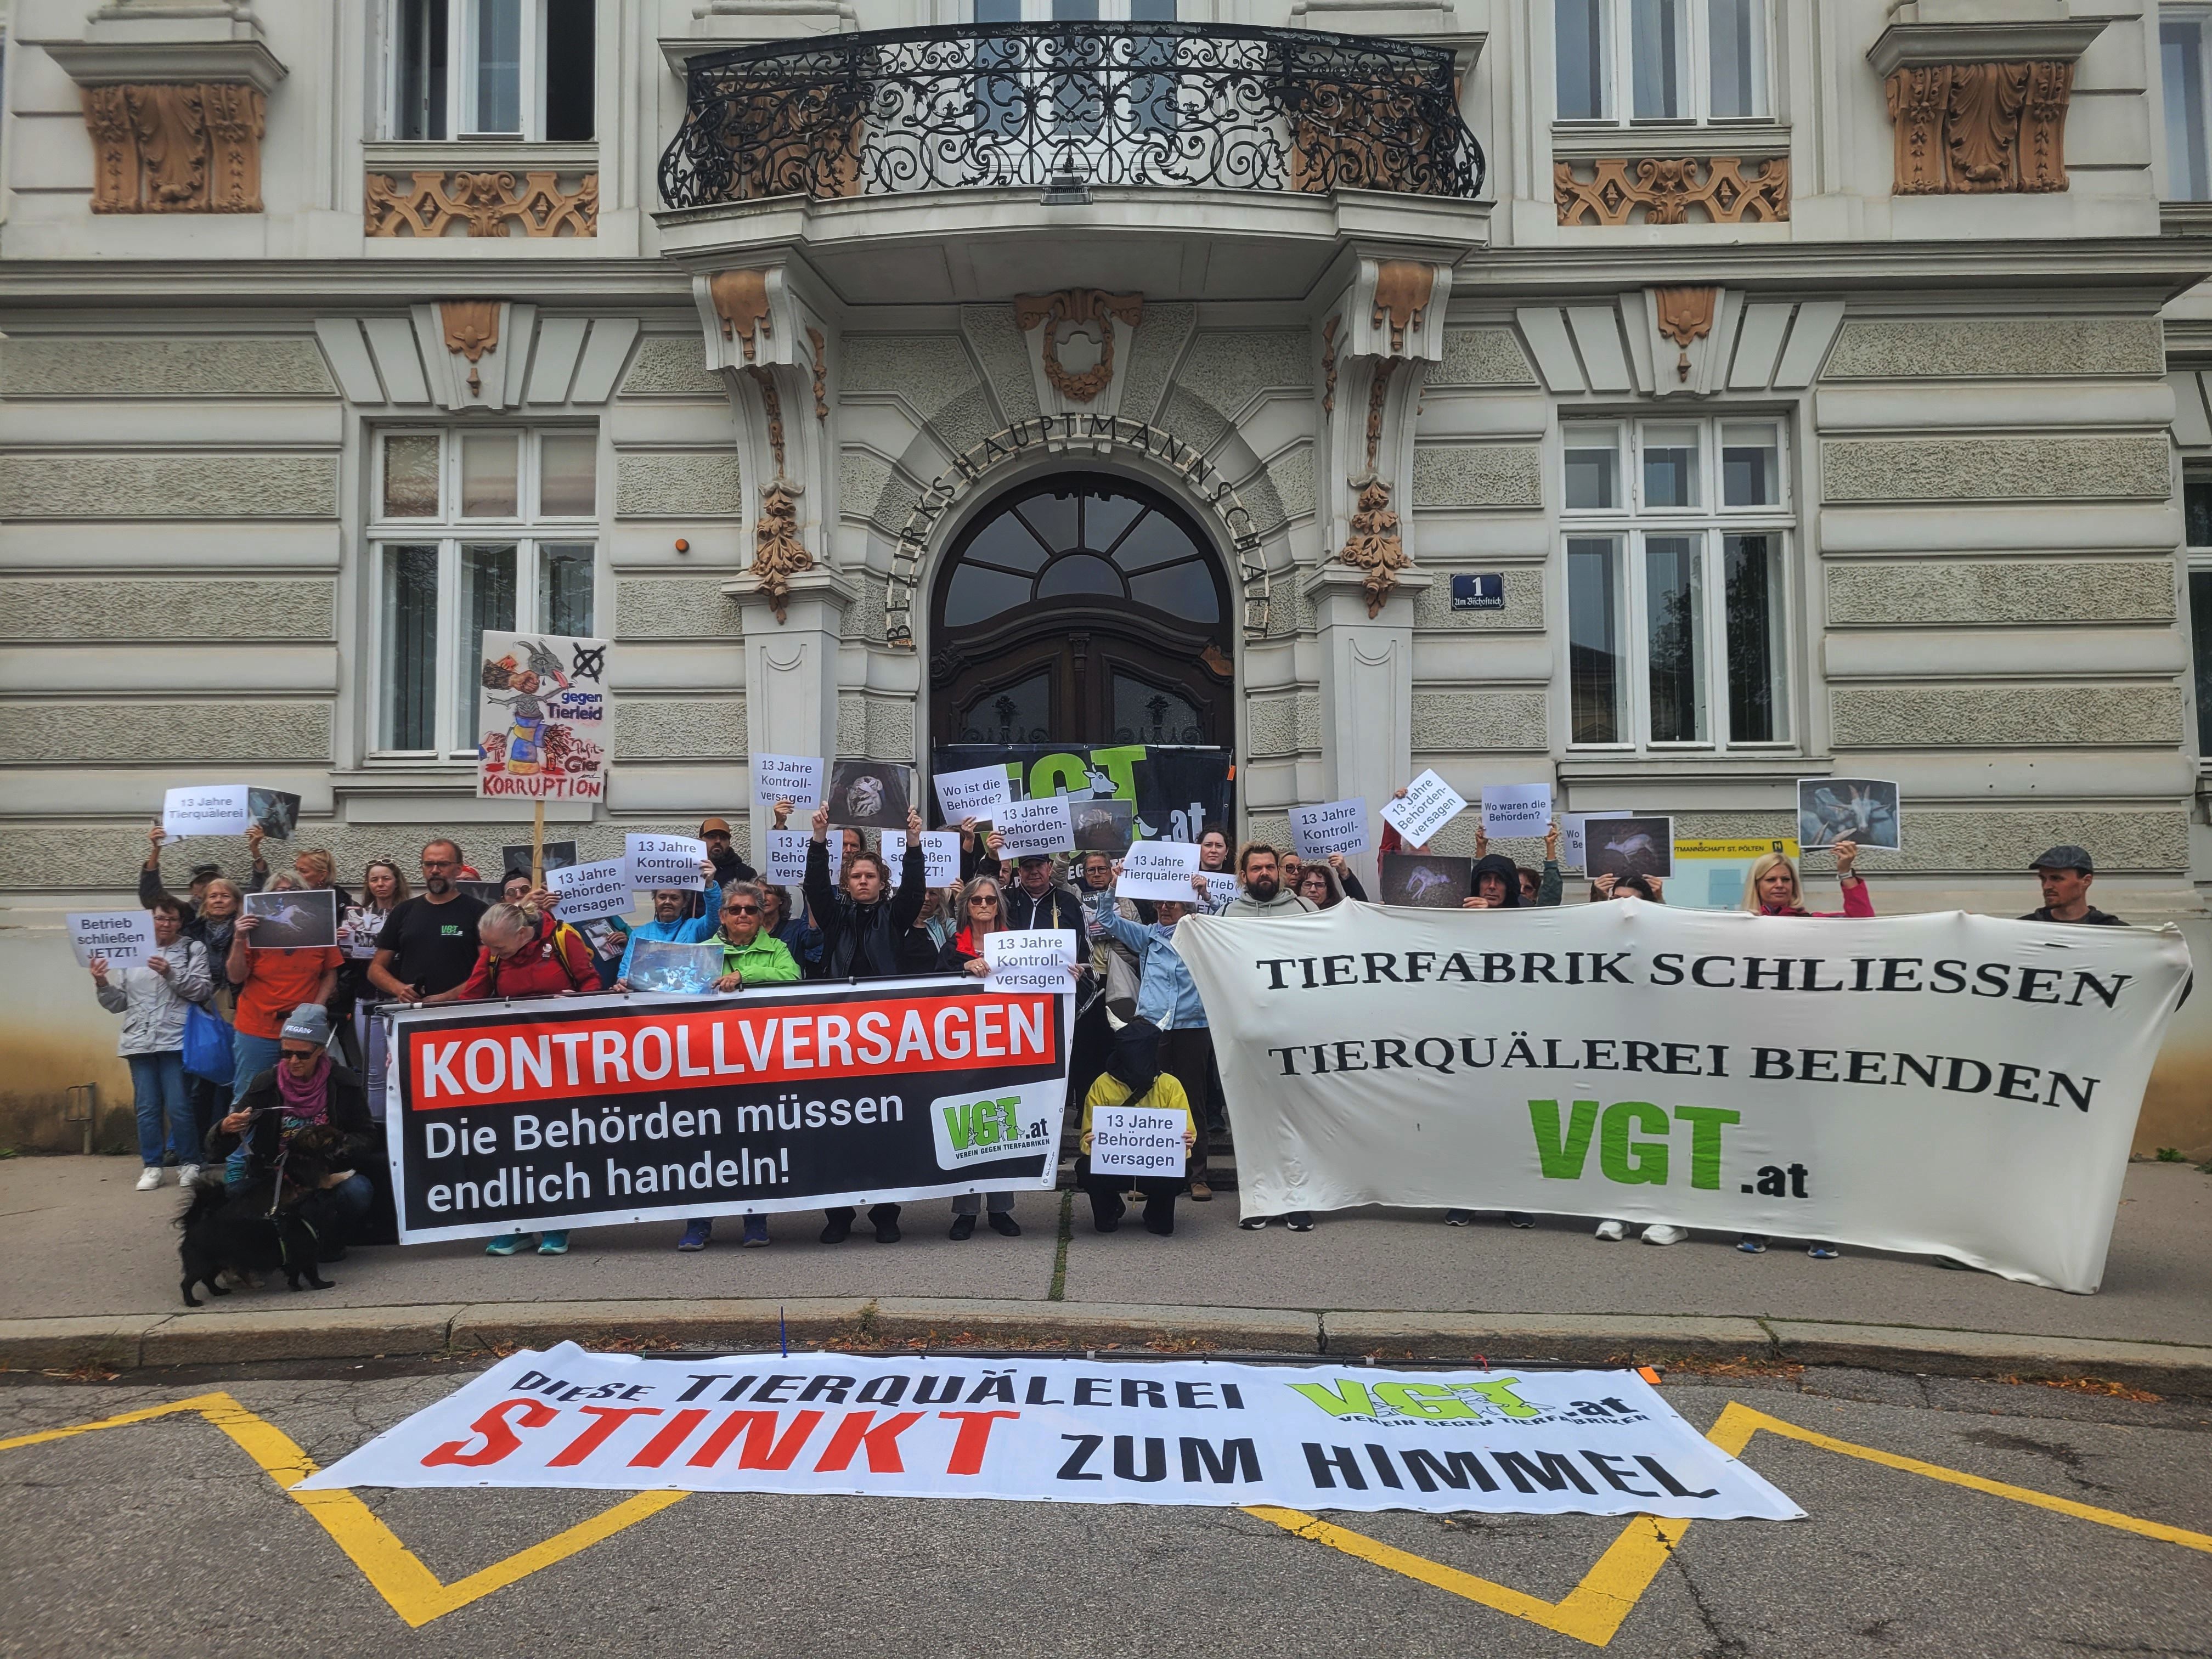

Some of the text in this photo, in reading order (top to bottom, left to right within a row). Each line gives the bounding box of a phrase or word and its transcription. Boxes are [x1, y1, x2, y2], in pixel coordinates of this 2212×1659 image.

[1472, 577, 1483, 596] 1
[1454, 597, 1466, 606] Am
[561, 692, 603, 705] gegen
[546, 702, 603, 720] Tierleid
[565, 755, 601, 773] Gier
[762, 760, 812, 774] 13 Jahre
[482, 775, 601, 797] KORRUPTION
[761, 775, 811, 788] Kontroll-
[943, 780, 1001, 797] Wo ist die
[181, 798, 233, 806] 13 Jahre
[761, 792, 811, 805] versagen
[946, 793, 1002, 810] Behörde?
[1392, 780, 1433, 815] 13 Jahre
[1003, 805, 1058, 820] 13 Jahre
[1397, 788, 1446, 830] Behörden-
[1485, 803, 1497, 811] Wo
[1531, 800, 1546, 809] die
[169, 808, 243, 820] Tierquälerei
[1302, 807, 1356, 825] 13 Jahre
[1412, 798, 1456, 837] versagen
[1489, 811, 1541, 821] Behörden?
[998, 820, 1067, 836] Behörden-
[1303, 821, 1358, 840] Kontroll-
[638, 841, 696, 853] 13 Jahre
[778, 837, 833, 848] 13 Jae
[1005, 835, 1065, 850] versagen
[1305, 838, 1361, 854] versagen
[637, 857, 698, 868] Kontroll-
[772, 850, 838, 862] Behön-
[890, 852, 951, 862] sceßen
[1134, 856, 1147, 865] 13
[1150, 856, 1184, 867] Jahre
[558, 867, 617, 884] 13 Jahre
[635, 874, 698, 885] versagen
[776, 869, 833, 878] versn
[1123, 868, 1193, 883] Tierquälerei
[554, 882, 625, 900] Behörden-
[1206, 878, 1234, 890] trieb
[560, 896, 624, 915] versagen
[81, 918, 132, 930] Betrieb
[77, 933, 145, 945] schließen
[997, 936, 1063, 950] 13 Jahre
[87, 947, 138, 959] JETZT!
[997, 953, 1063, 967] Kontroll-
[996, 974, 1064, 988] versagen
[1256, 951, 2132, 1009] TIERFABRIK SCHLIESSEN
[285, 1025, 313, 1034] VEGAN
[422, 1002, 1045, 1098] KONTROLLVERSAGEN
[1268, 1031, 2101, 1113] TIERQUÄLEREI BEENDEN
[425, 1094, 904, 1159] Die Behörden müssen
[1106, 1114, 1173, 1130] 13 Jahre
[1098, 1131, 1181, 1148] Behörden-
[956, 1138, 1050, 1160] VEREIN GEGEN TIERFABRIKEN
[1101, 1153, 1175, 1169] versagen
[427, 1148, 789, 1212] endlich handeln!
[510, 1370, 657, 1402] DIESE
[675, 1368, 1245, 1410] TIERQUÄLEREI
[1339, 1413, 1652, 1427] VEREIN GEGEN TIERFABRIKEN
[420, 1398, 1721, 1499] STINKT ZUM HIMMEL
